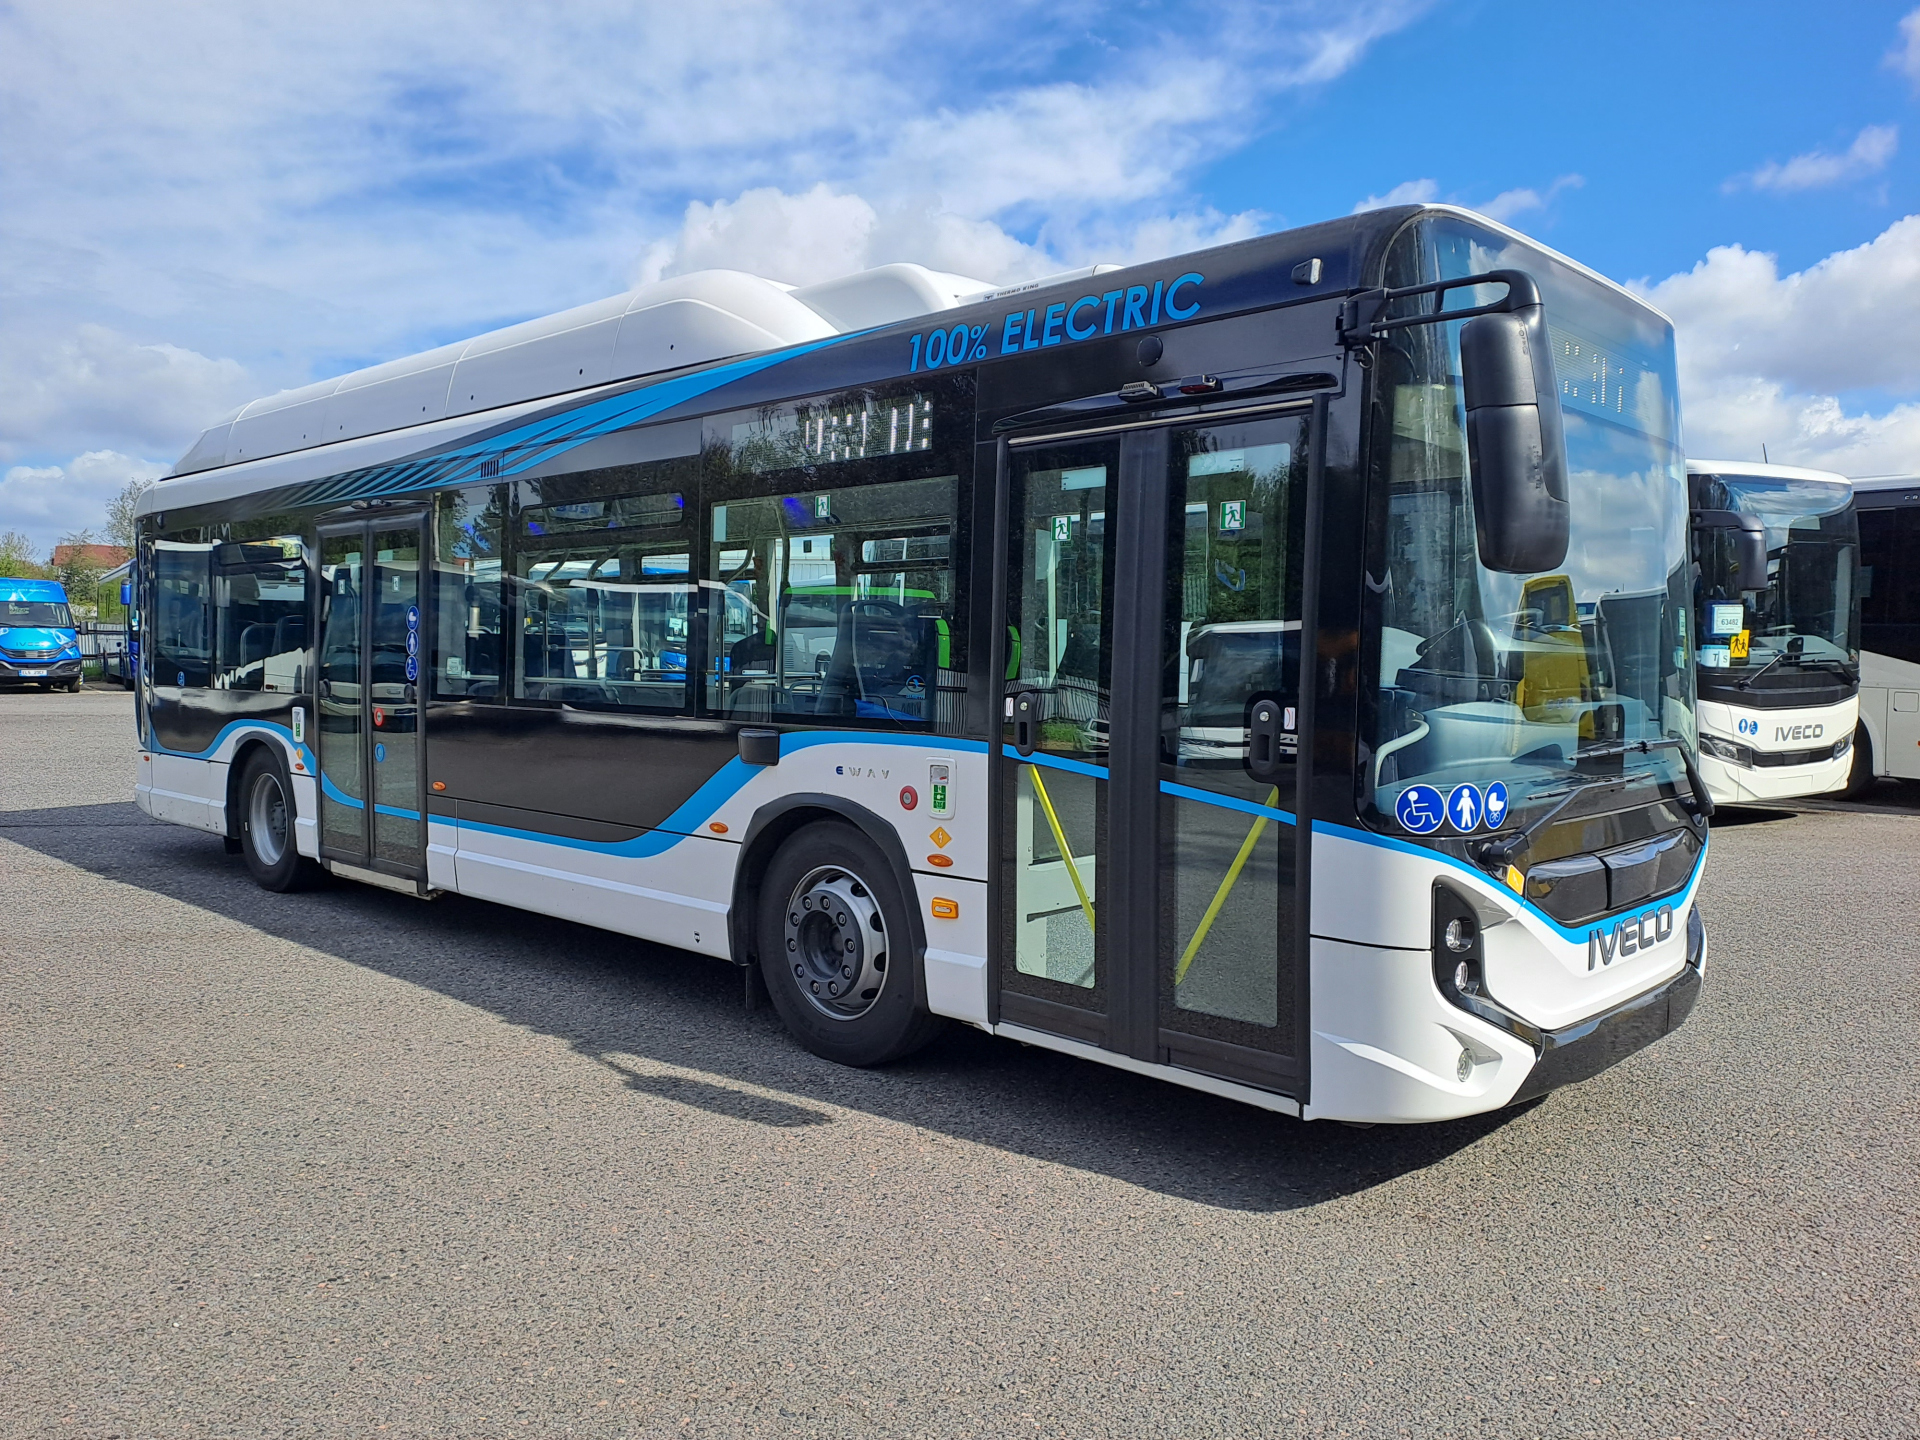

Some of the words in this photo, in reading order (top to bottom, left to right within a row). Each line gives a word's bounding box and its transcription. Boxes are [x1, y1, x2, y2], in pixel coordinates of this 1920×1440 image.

[997, 288, 1021, 297] THERMO
[1022, 283, 1039, 291] KING
[909, 322, 990, 372] 100%
[1001, 272, 1205, 355] ELECTRIC
[1721, 618, 1739, 626] 63482
[1774, 723, 1824, 742] IVECO
[1588, 903, 1673, 972] IVECO
